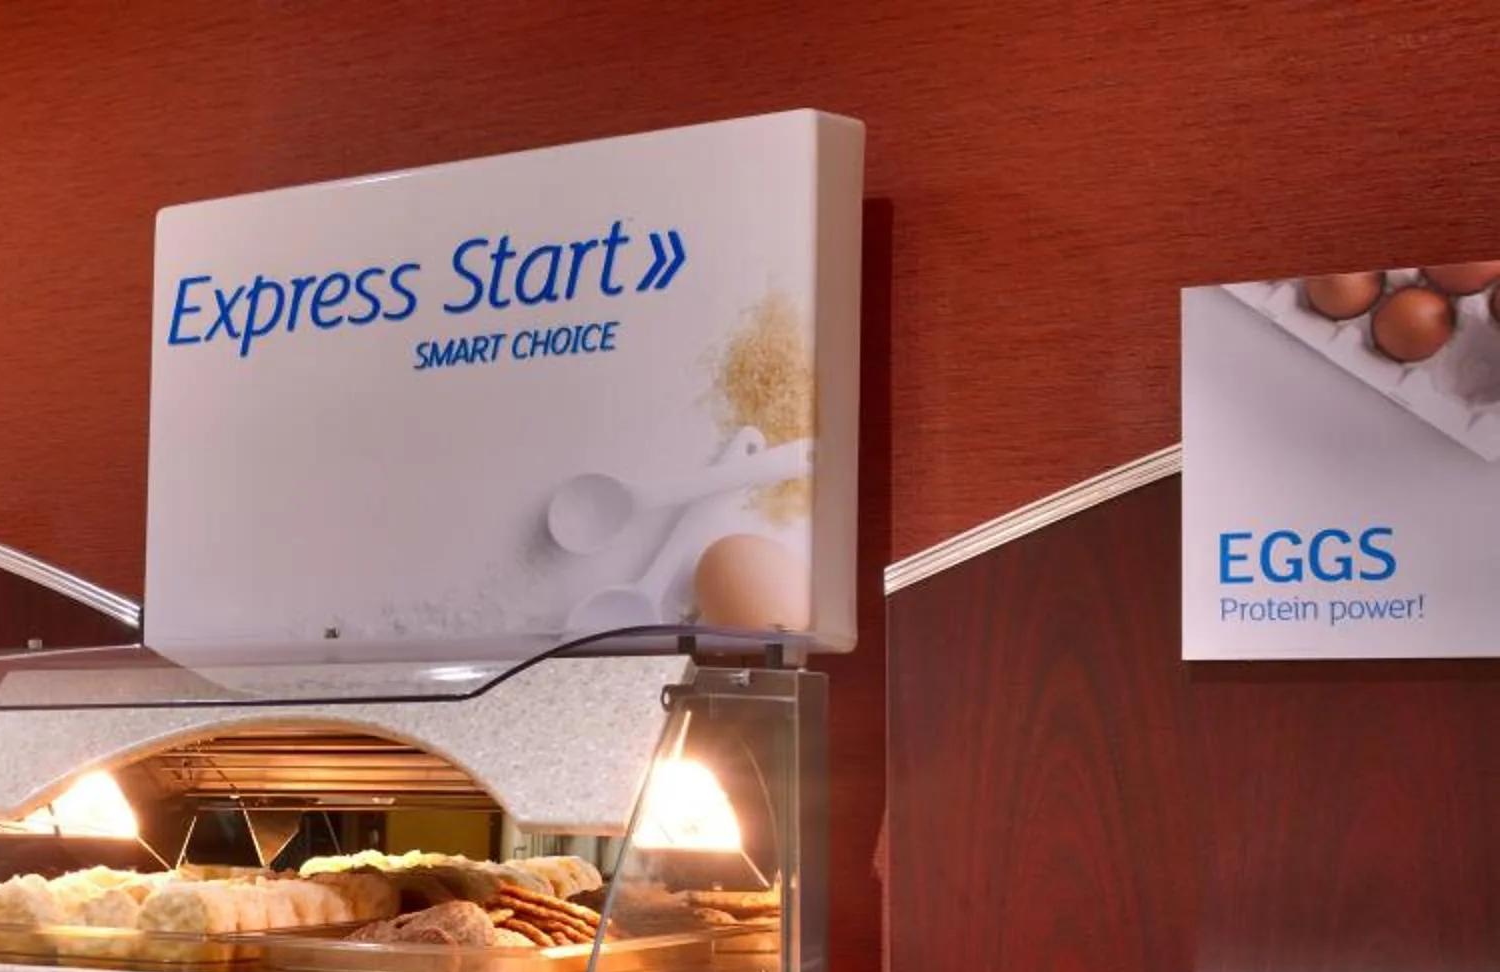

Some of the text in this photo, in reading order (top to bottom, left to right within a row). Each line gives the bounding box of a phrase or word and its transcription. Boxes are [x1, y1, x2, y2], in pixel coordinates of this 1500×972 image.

[167, 220, 630, 357] Express Start
[413, 321, 620, 370] SMART CHOICE
[1219, 527, 1397, 584] EGGS
[1220, 594, 1425, 626] Protein power!
